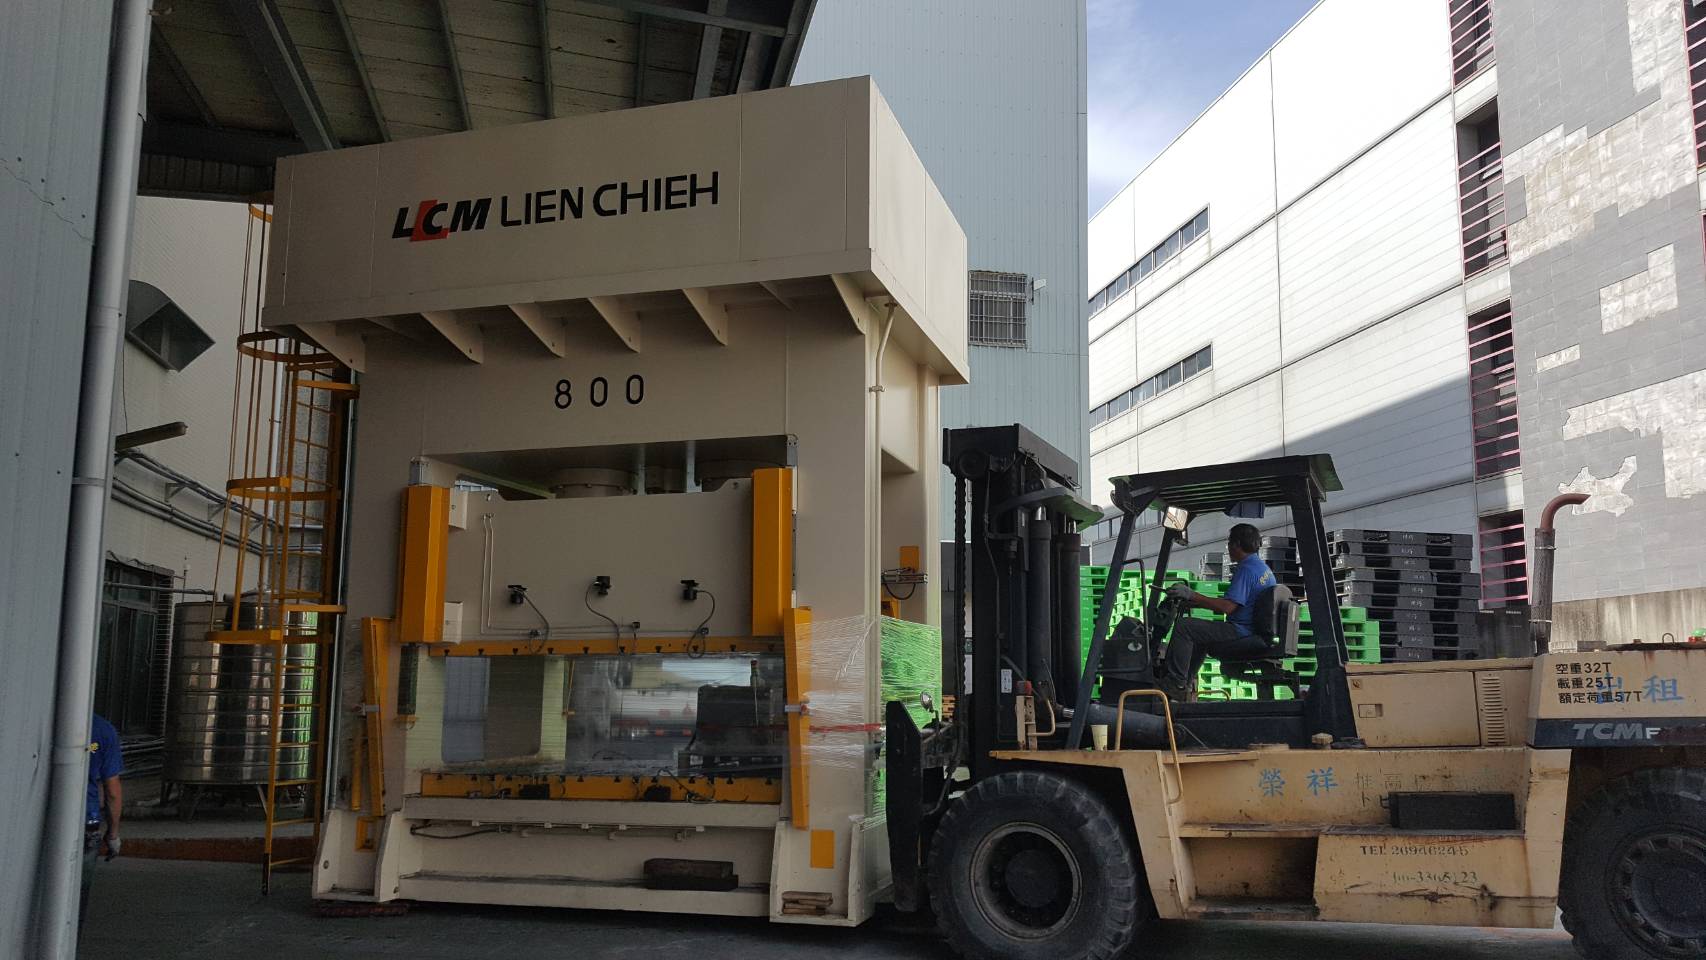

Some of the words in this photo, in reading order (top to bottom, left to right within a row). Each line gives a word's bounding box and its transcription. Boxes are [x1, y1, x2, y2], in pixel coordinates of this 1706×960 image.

[392, 198, 492, 241] LCM
[501, 186, 584, 227] LIEN
[593, 171, 718, 216] CHIEH
[1555, 661, 1612, 675] 空重32T
[1572, 722, 1643, 741] TCM
